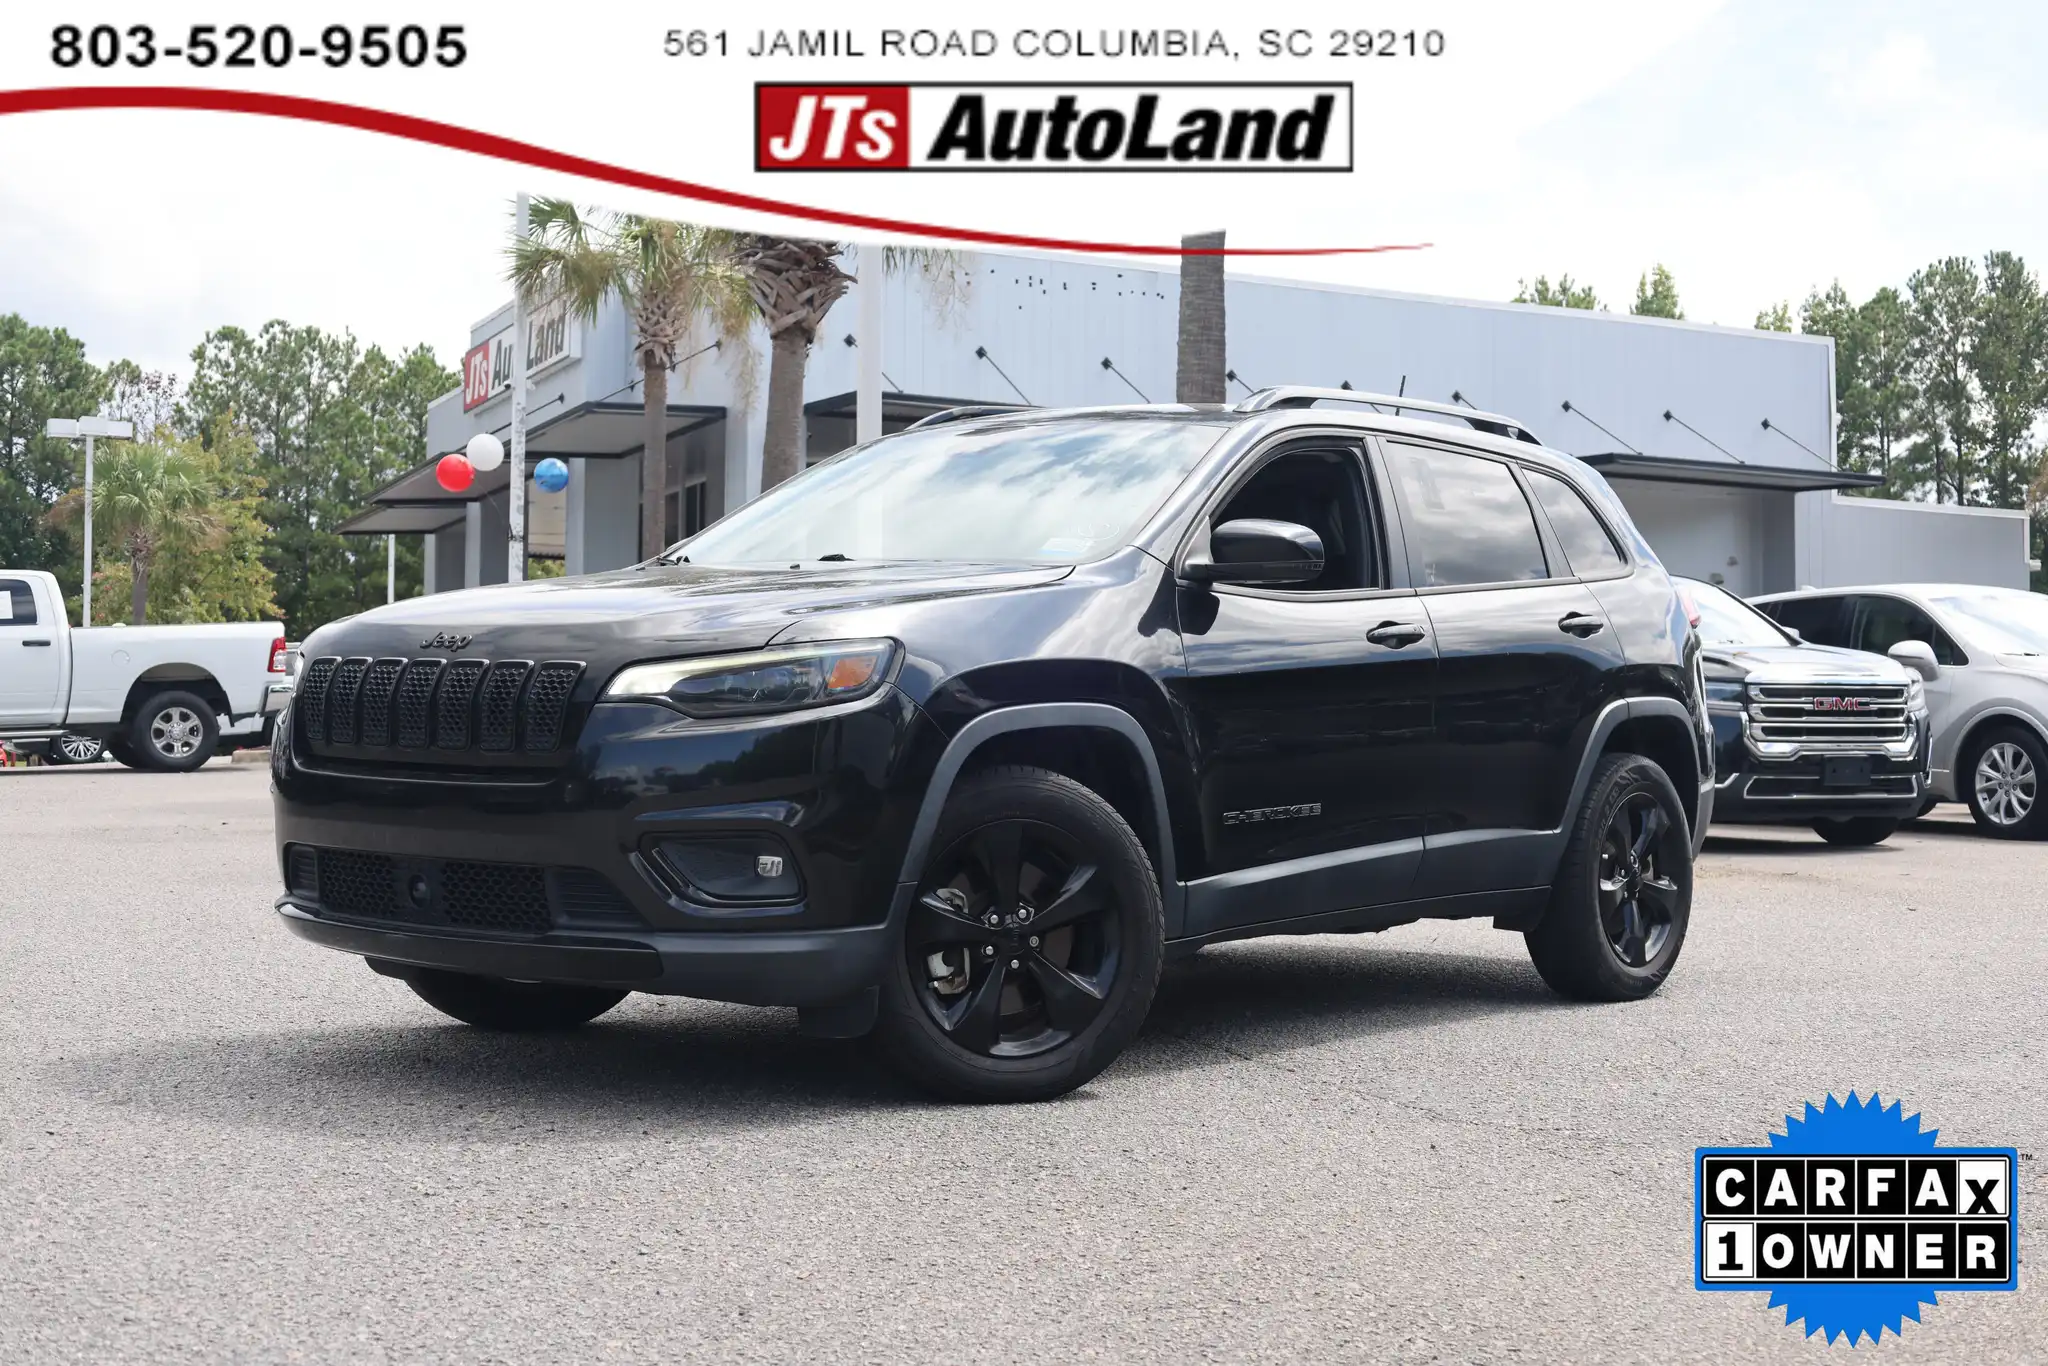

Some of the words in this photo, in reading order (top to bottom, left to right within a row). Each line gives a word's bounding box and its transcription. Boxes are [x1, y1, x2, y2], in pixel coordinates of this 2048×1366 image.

[466, 350, 488, 405] JTs
[491, 301, 567, 391] AuLand
[420, 631, 473, 653] Jeep
[1814, 696, 1871, 711] GMC
